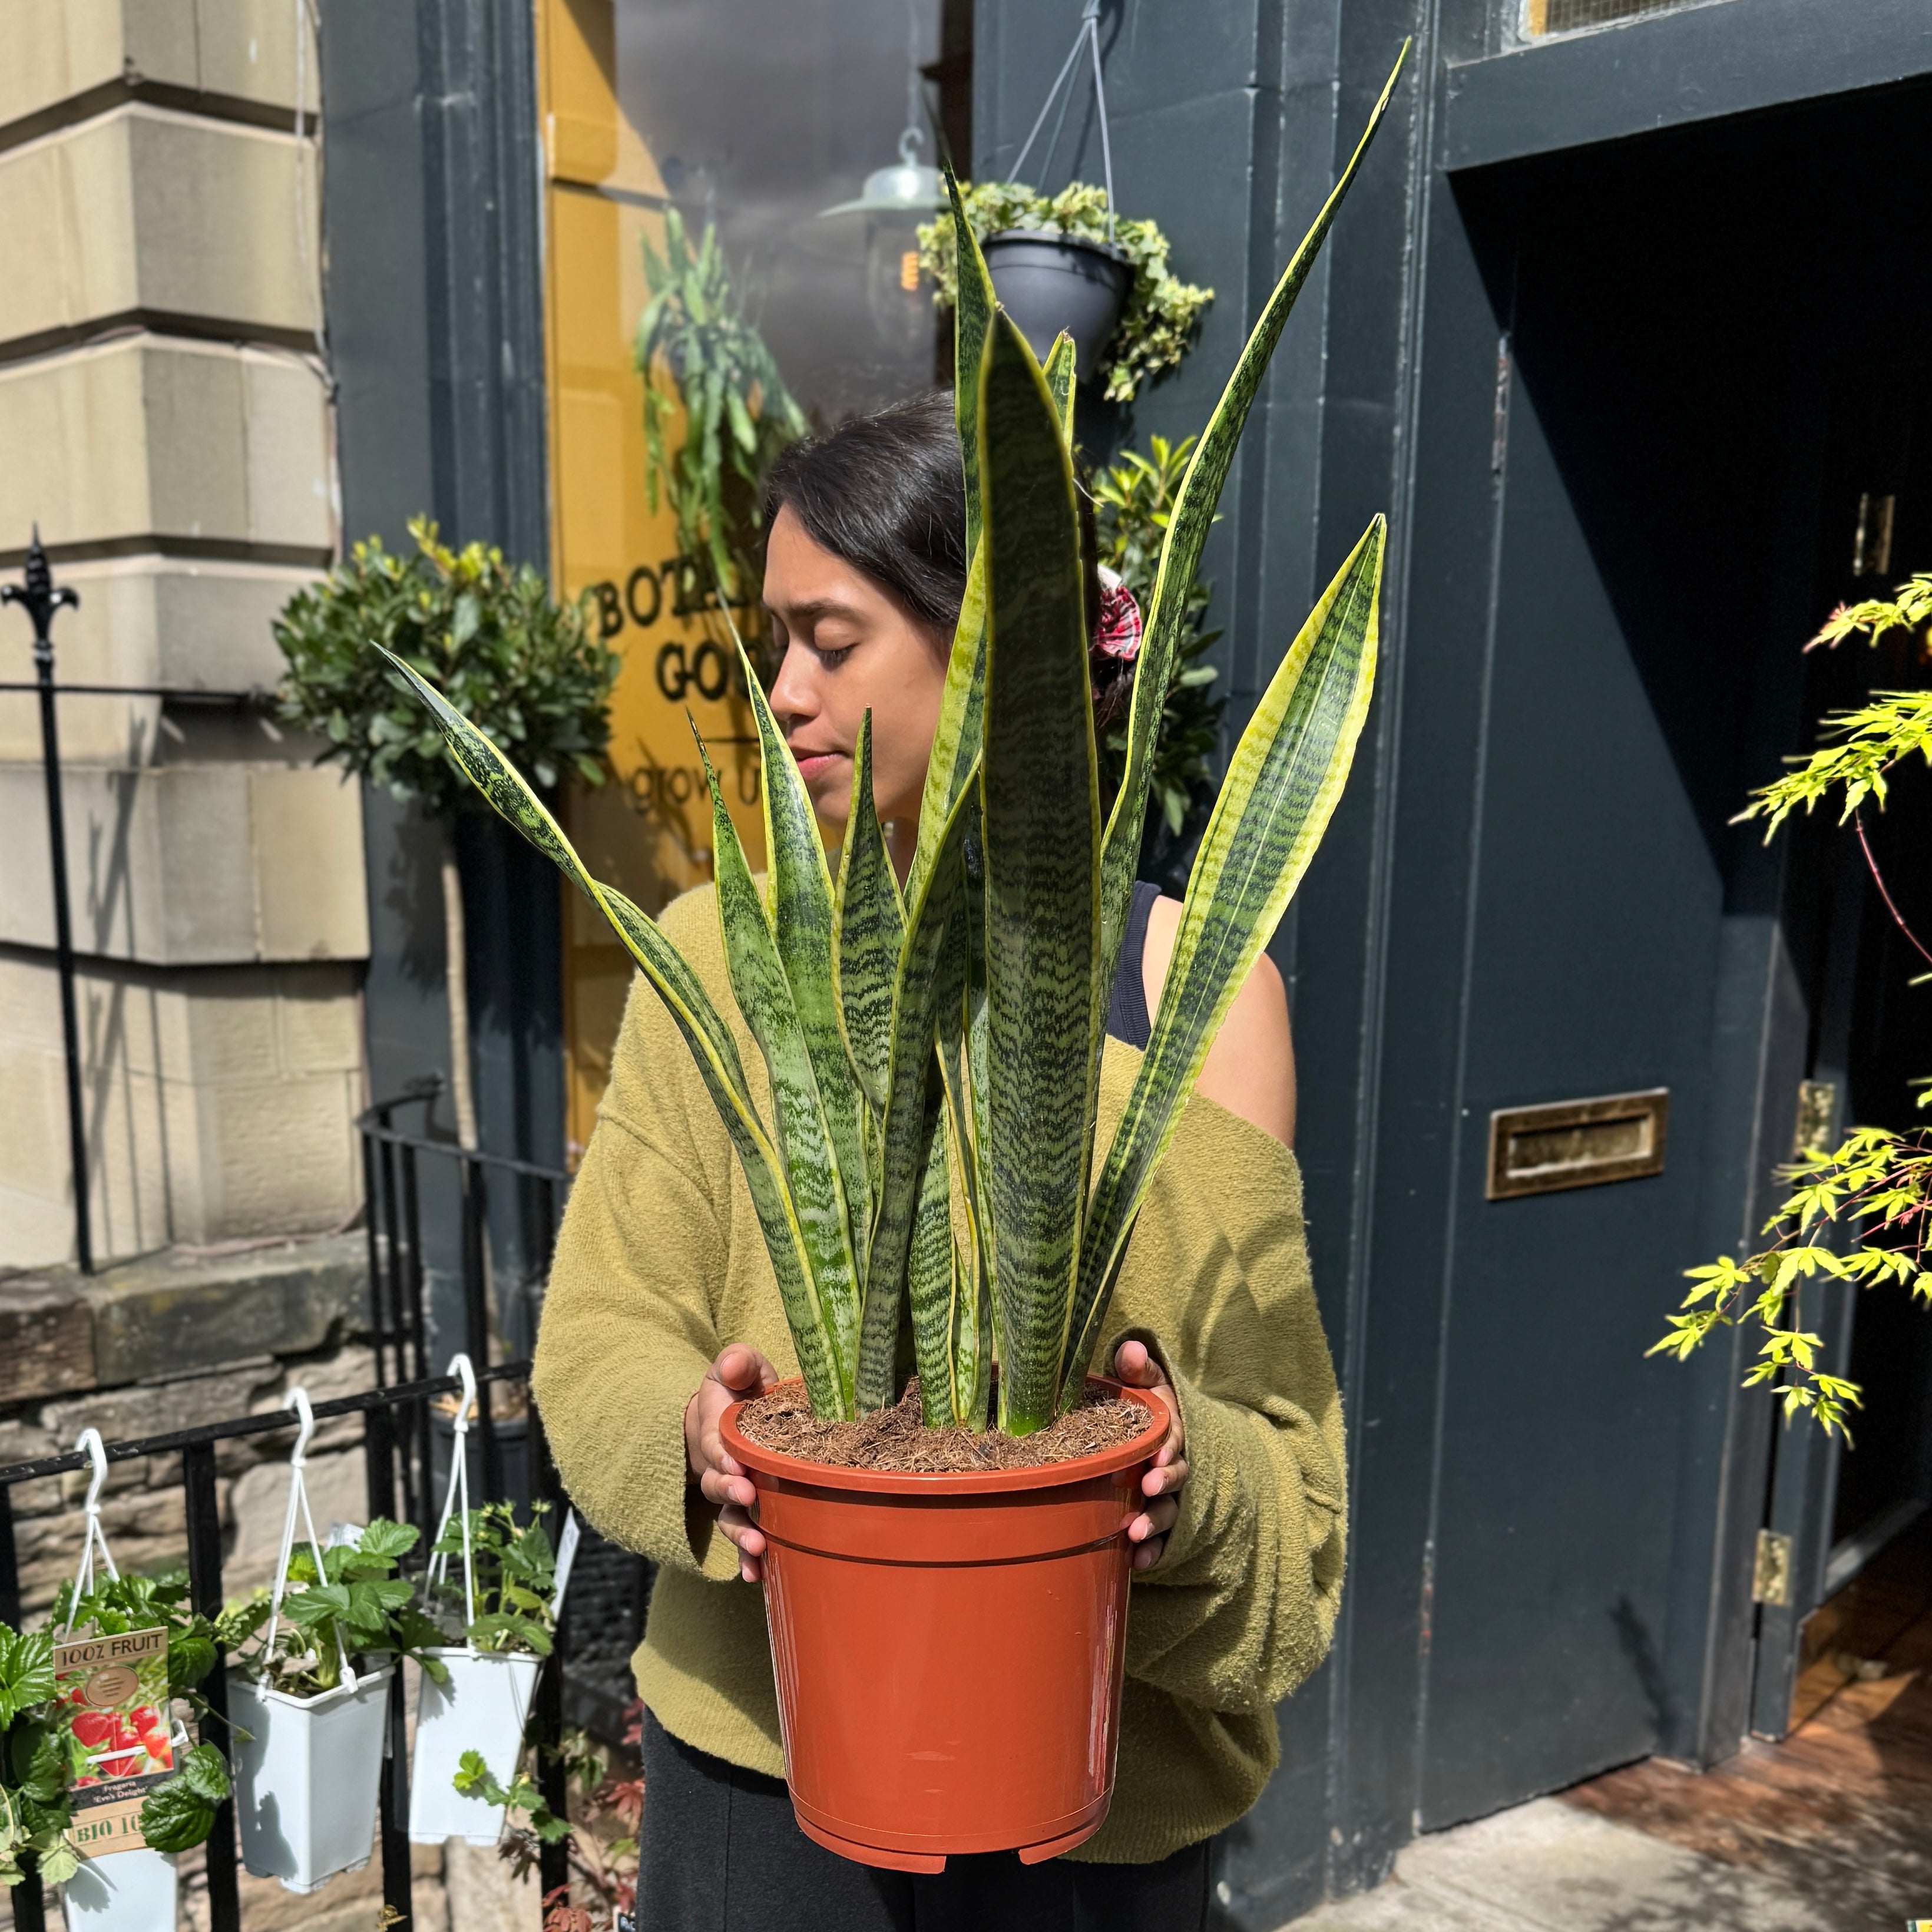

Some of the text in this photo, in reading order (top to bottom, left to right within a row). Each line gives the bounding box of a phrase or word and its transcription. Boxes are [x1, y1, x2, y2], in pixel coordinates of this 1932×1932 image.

[63, 1633, 163, 1666] 100% FRUIT
[104, 1781, 136, 1791] Fragaria
[77, 1820, 113, 1842] BIO
